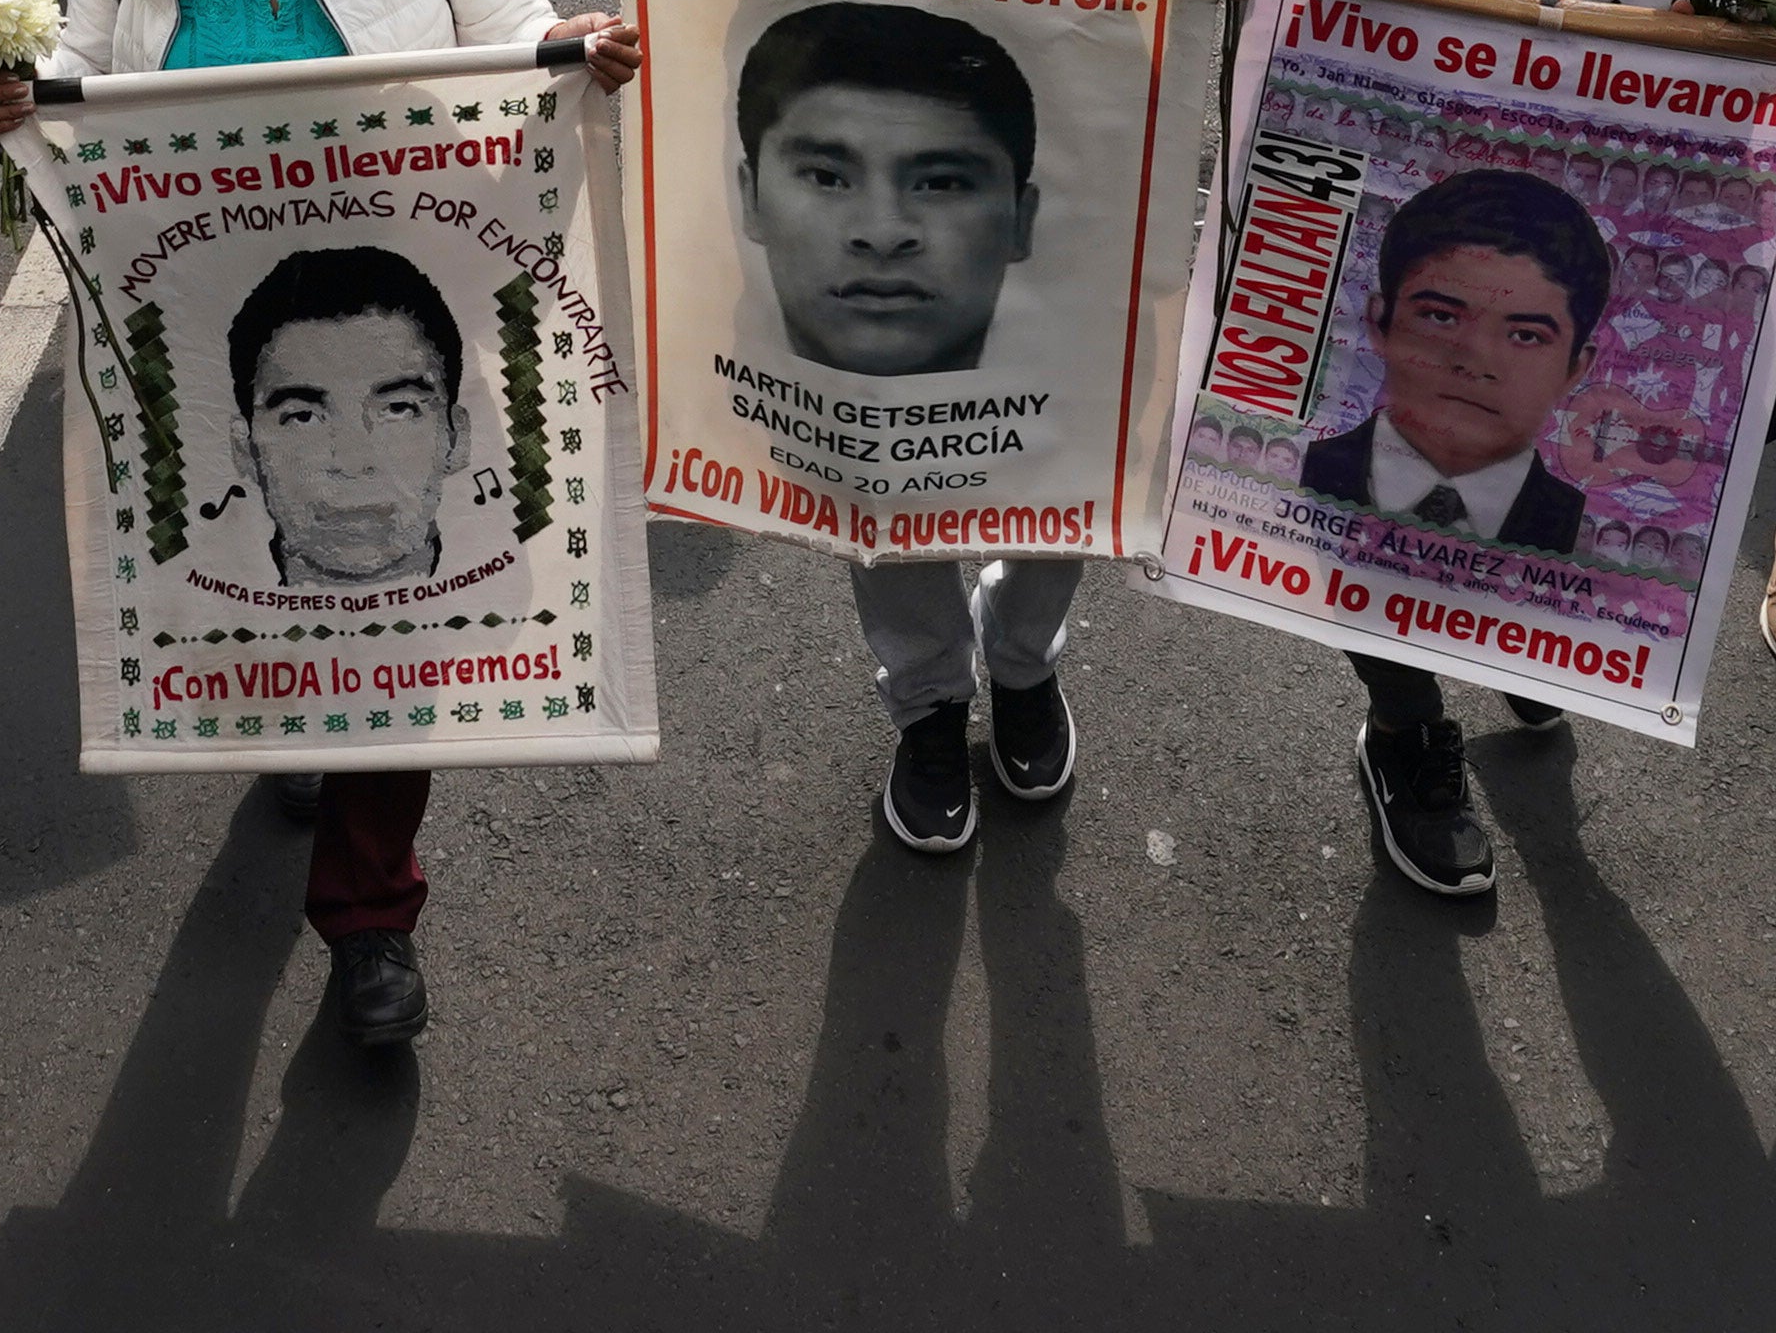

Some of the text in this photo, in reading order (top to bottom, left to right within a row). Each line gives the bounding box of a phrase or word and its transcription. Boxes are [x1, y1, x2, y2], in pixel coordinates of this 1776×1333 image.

[1433, 30, 1498, 81] se
[1511, 37, 1562, 91] lo
[90, 128, 525, 214] ¡Vivo se lo llevaron!
[118, 189, 629, 406] MOVERE MONTAÑAS POR ENCONTRARTE
[1210, 129, 1365, 417] NOS FALTAN 43!
[713, 353, 1051, 430] MARTÍN GETSEMANY
[731, 393, 1024, 463] SÁNCHEZ GARCÍA
[664, 447, 1096, 552] ¡Con VIDA lo queremos!
[768, 445, 988, 496] EDAD 20 AÑOS
[186, 549, 516, 614] NUNCA ESPERES QUE TE OLVIDEMOS
[1191, 499, 1671, 637] Hijo de Epifanio y Blanca 19 años Juan R. Escudero
[1278, 498, 1594, 597] JORGE ÁLVAREZ NAVA
[1186, 528, 1653, 690] ¡Vivo lo queremos!
[152, 644, 563, 711] ¡Con VIDA lo queremos!
